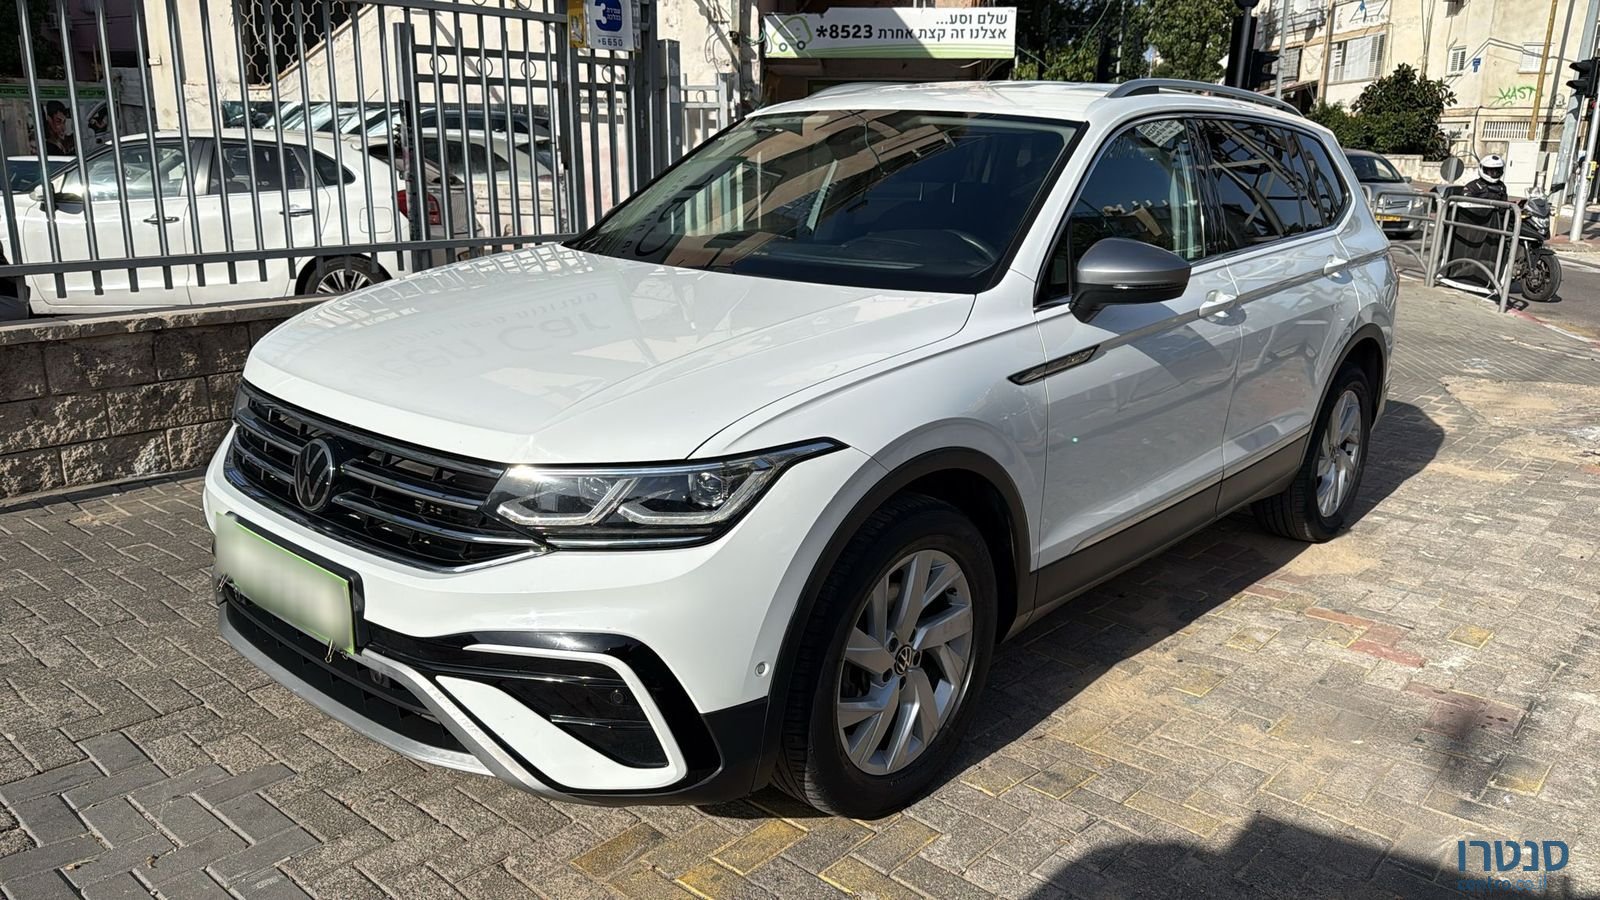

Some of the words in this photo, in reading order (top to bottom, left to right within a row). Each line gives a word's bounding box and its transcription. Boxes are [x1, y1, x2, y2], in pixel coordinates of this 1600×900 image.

[977, 11, 1008, 25] שלם
[877, 28, 914, 39] אחרת
[917, 28, 946, 42] קצת
[950, 28, 966, 39] זה
[969, 26, 1007, 39] אצלנו
